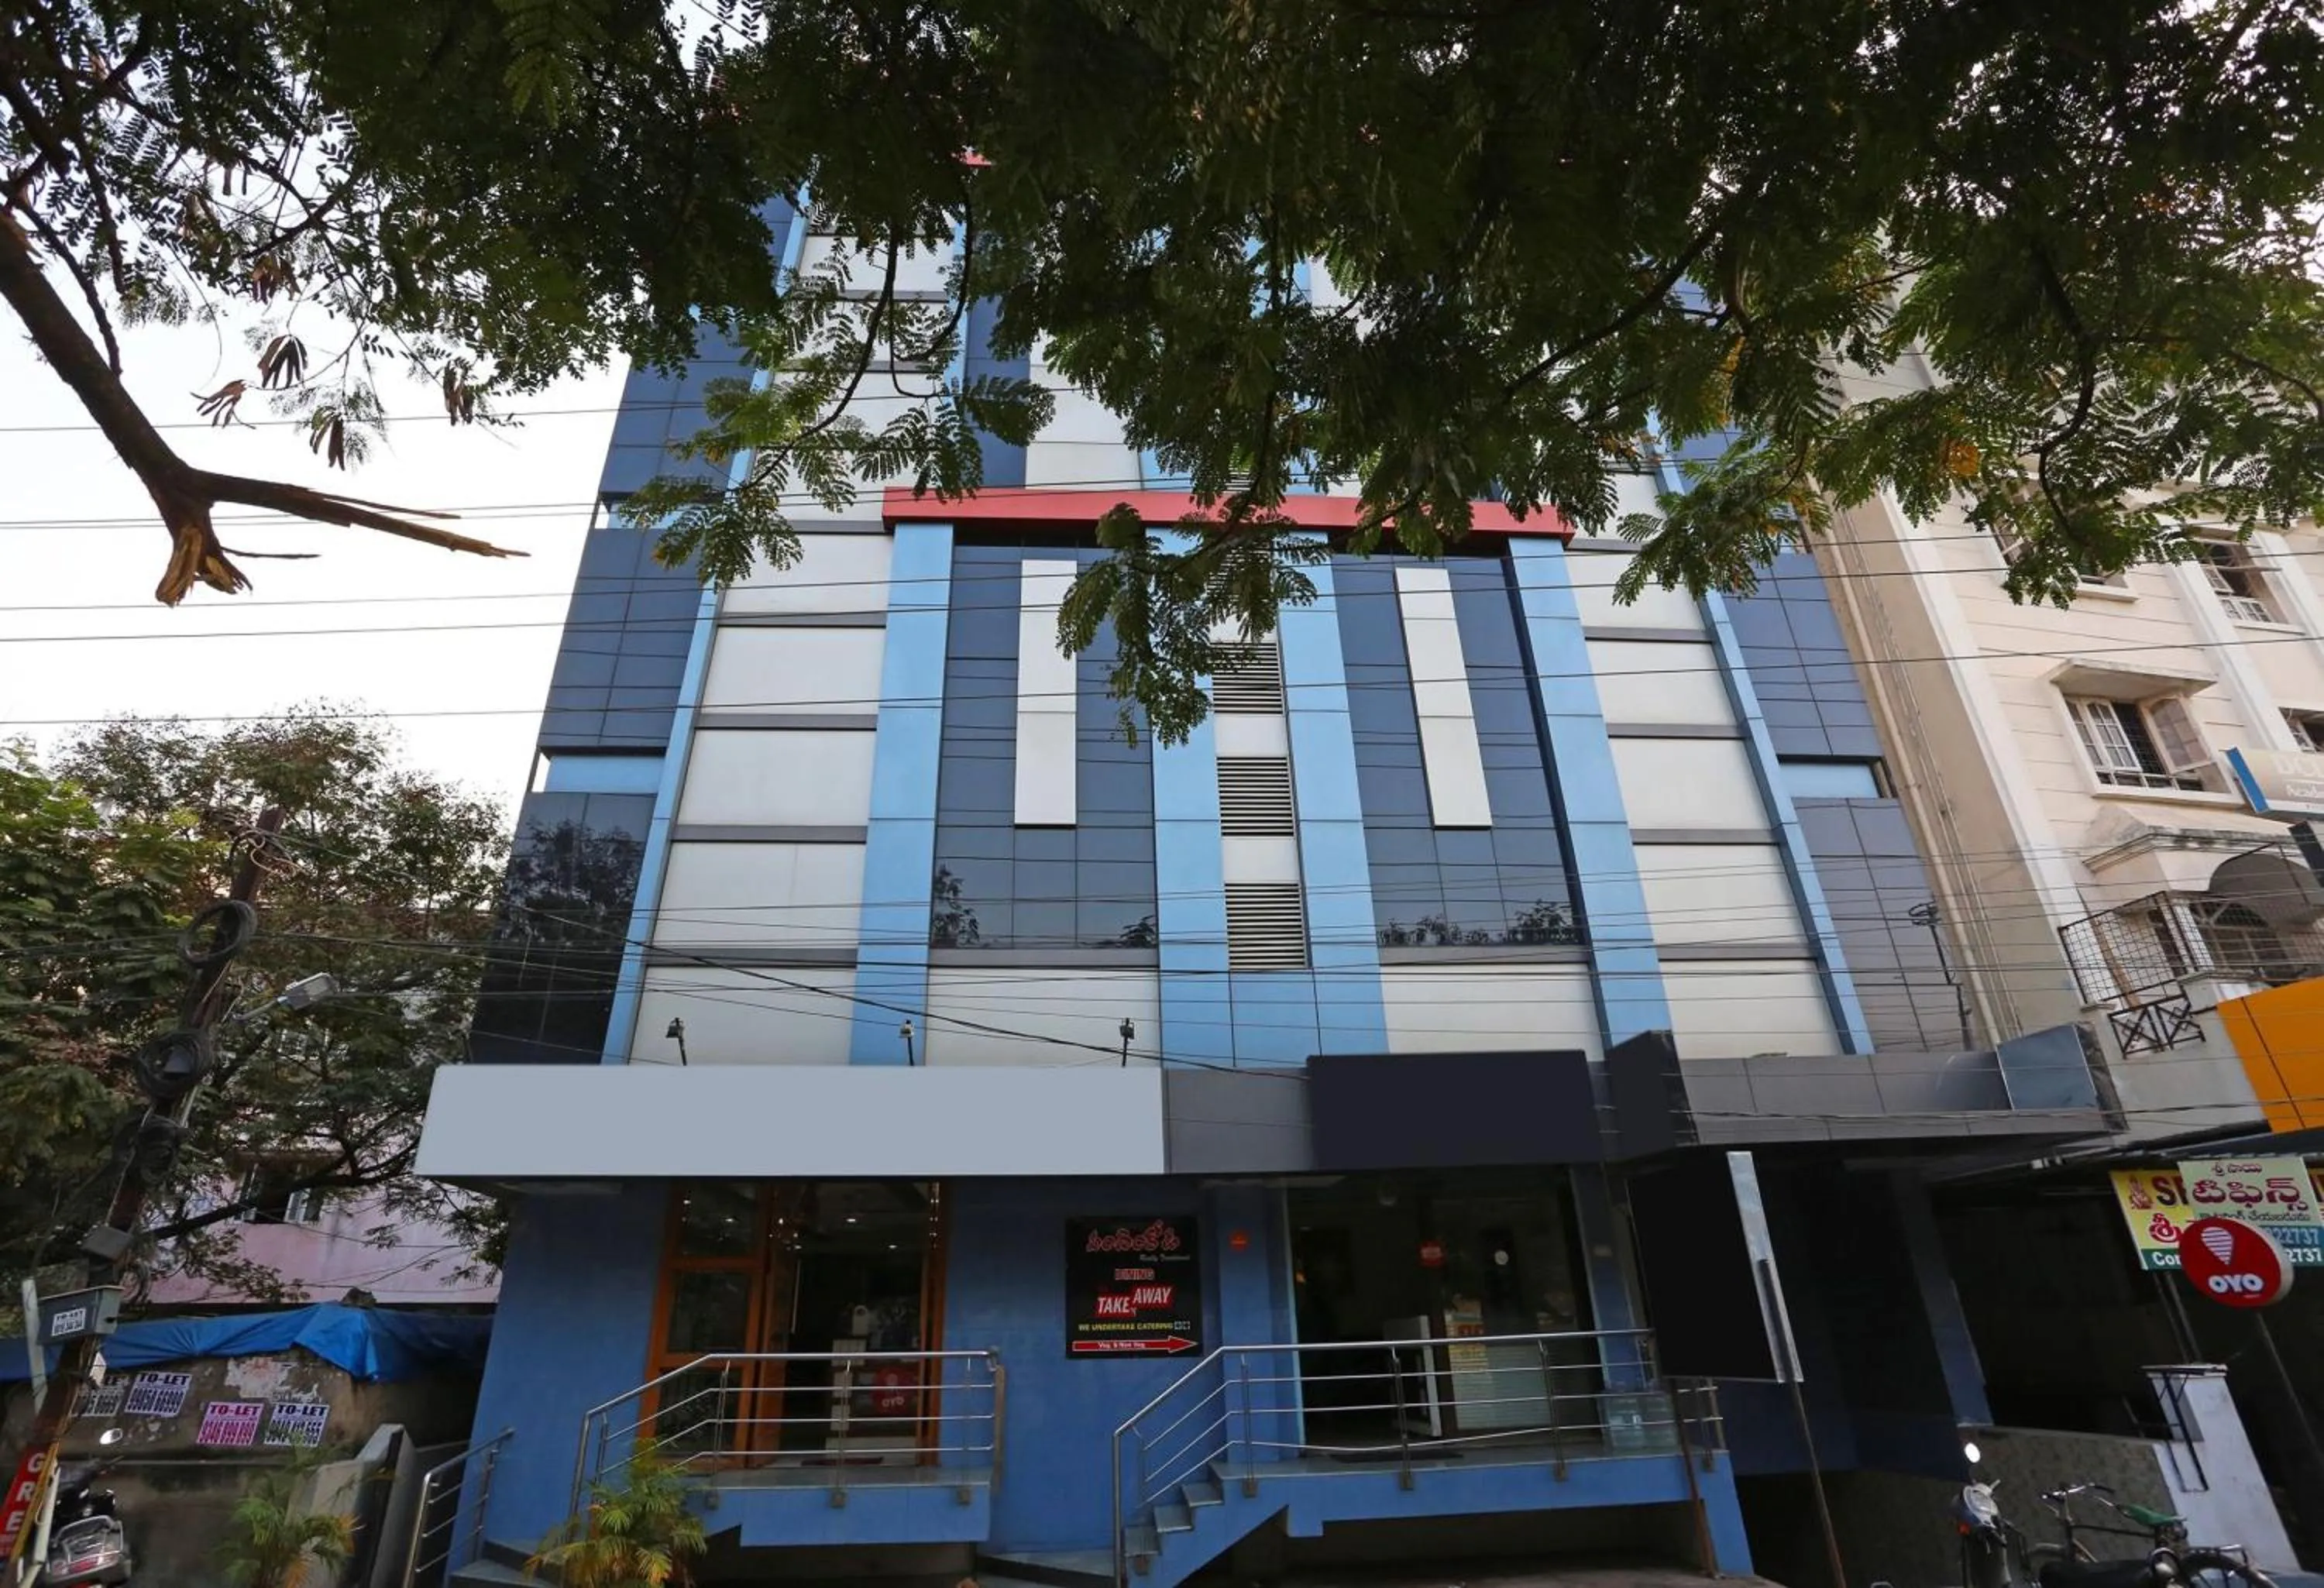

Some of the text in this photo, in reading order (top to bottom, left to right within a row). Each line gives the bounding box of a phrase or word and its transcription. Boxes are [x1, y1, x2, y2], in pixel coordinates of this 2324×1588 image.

[2208, 1273, 2264, 1294] OYO
[1097, 1287, 1172, 1315] TAKE AWAY
[139, 1373, 191, 1385] TO-LET
[210, 1404, 260, 1415] TO-LET
[277, 1404, 326, 1416] TO-LET
